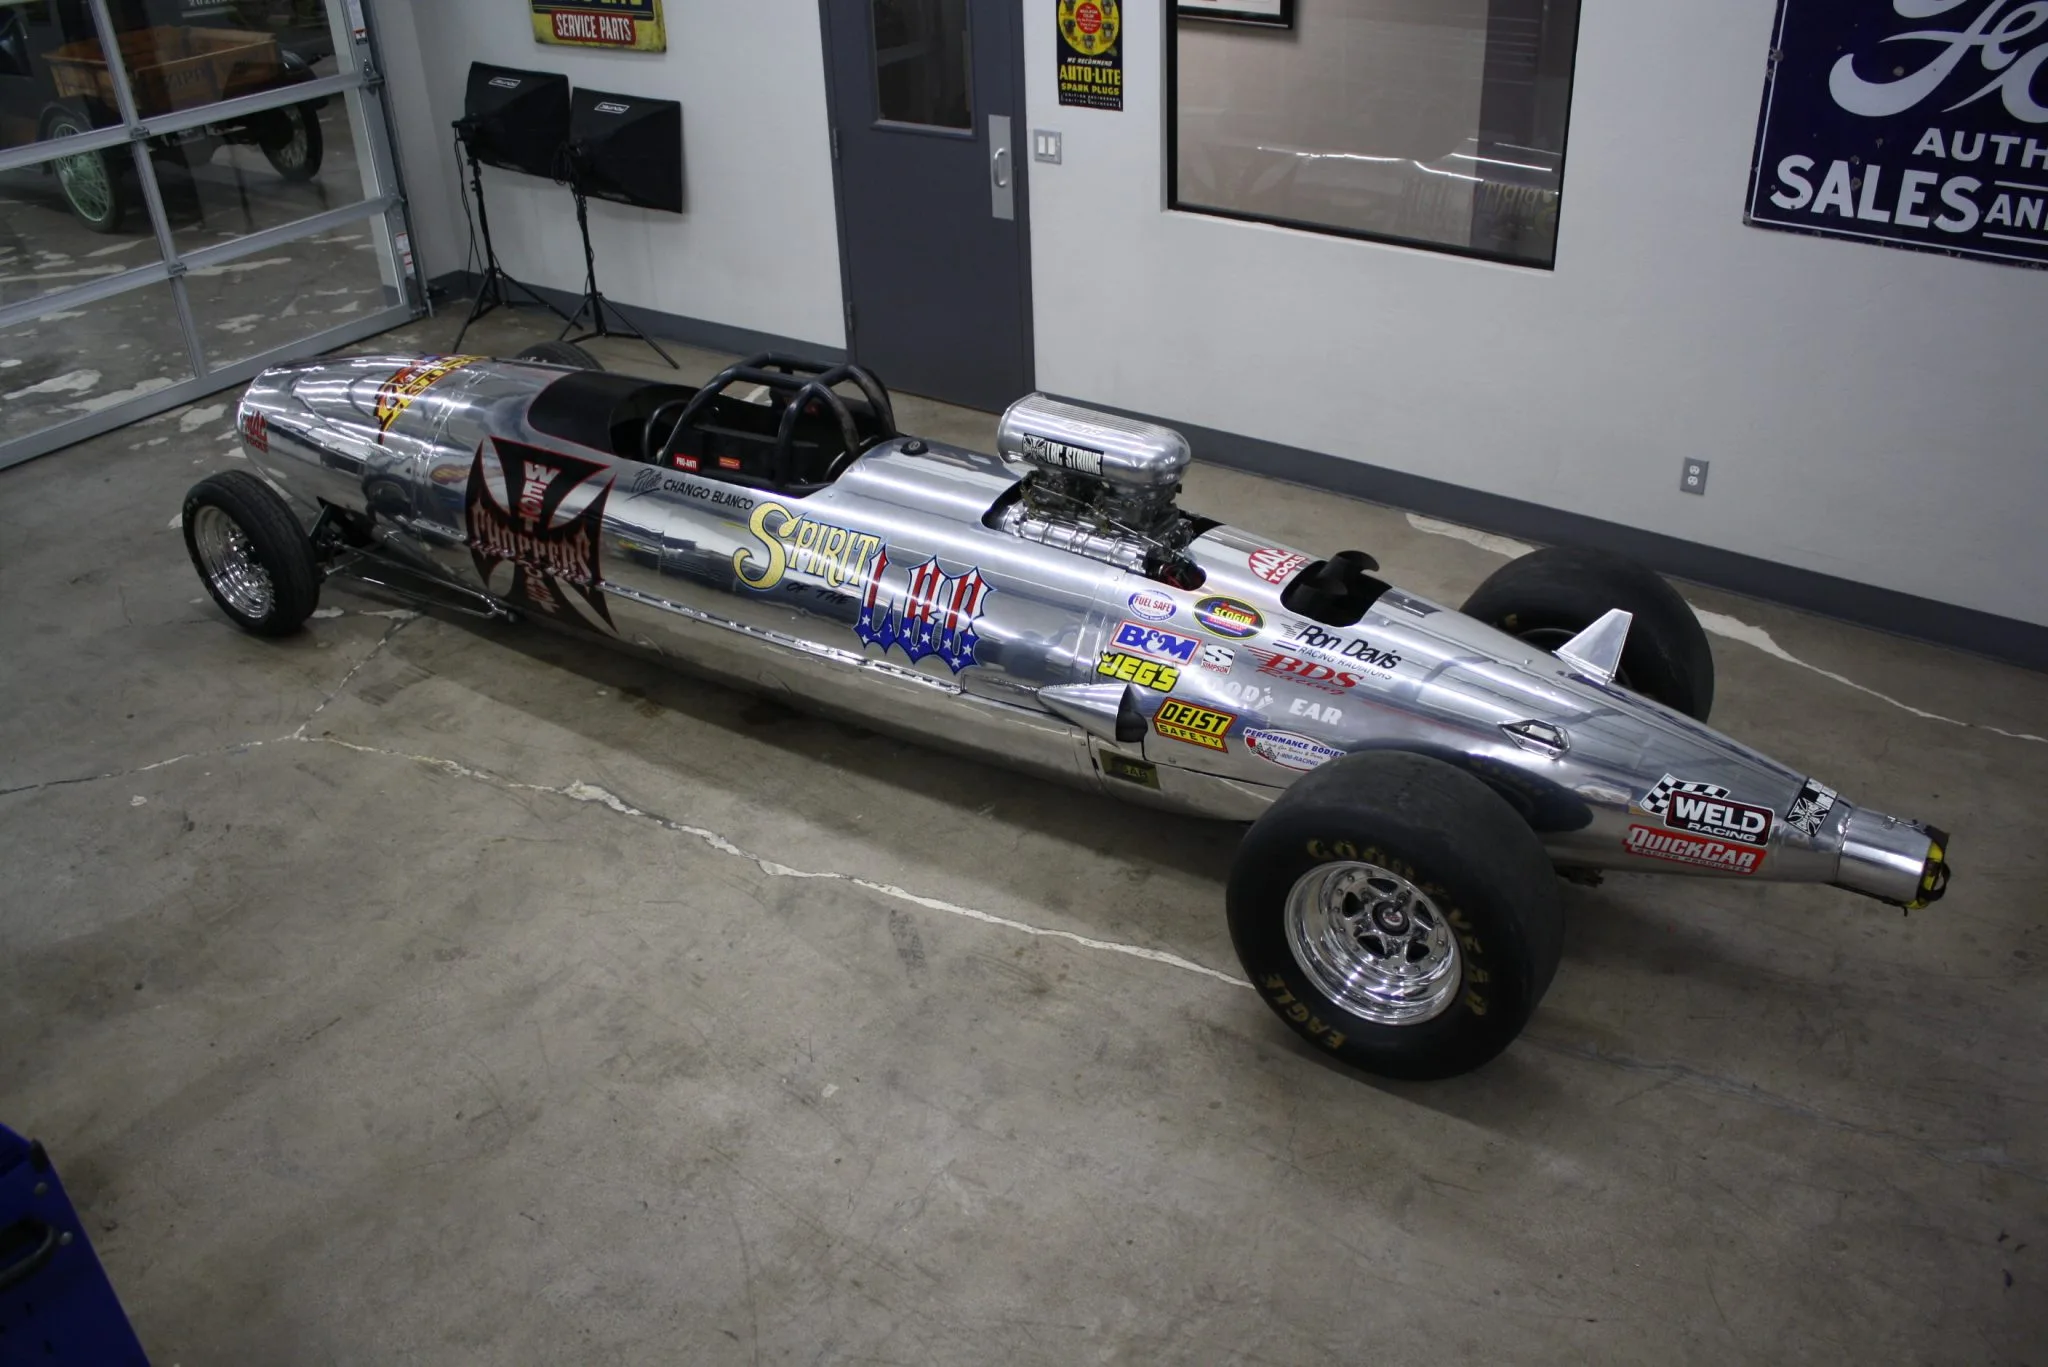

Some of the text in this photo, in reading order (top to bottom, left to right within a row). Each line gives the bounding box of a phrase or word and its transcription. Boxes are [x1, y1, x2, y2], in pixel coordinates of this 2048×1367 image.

[556, 13, 632, 41] SERVICE PARTS
[1060, 64, 1121, 86] AUTO-LITE
[1061, 82, 1120, 96] SPARK PLUGS
[1770, 154, 2048, 233] SALES AN
[1065, 445, 1102, 475] STRONG
[663, 479, 711, 500] CHANGO
[711, 490, 754, 510] BLANCO
[732, 501, 881, 591] SPIRIT
[786, 582, 856, 605] OF THE
[1134, 595, 1153, 608] FUEL
[1153, 599, 1171, 612] SAFE
[1212, 606, 1253, 625] SCOGIN
[1116, 624, 1197, 660] B&M
[1295, 624, 1401, 669] Ron Davis
[1298, 646, 1335, 663] RACING
[1098, 651, 1181, 693] JEG'S
[1202, 661, 1230, 674] SIMPSON
[1265, 653, 1364, 688] BDS
[1160, 702, 1229, 733] DEIST
[1159, 724, 1219, 746] SAFETY
[1245, 728, 1308, 750] PERFORMANCE
[1674, 796, 1766, 834] WELD
[1687, 822, 1757, 842] RACING
